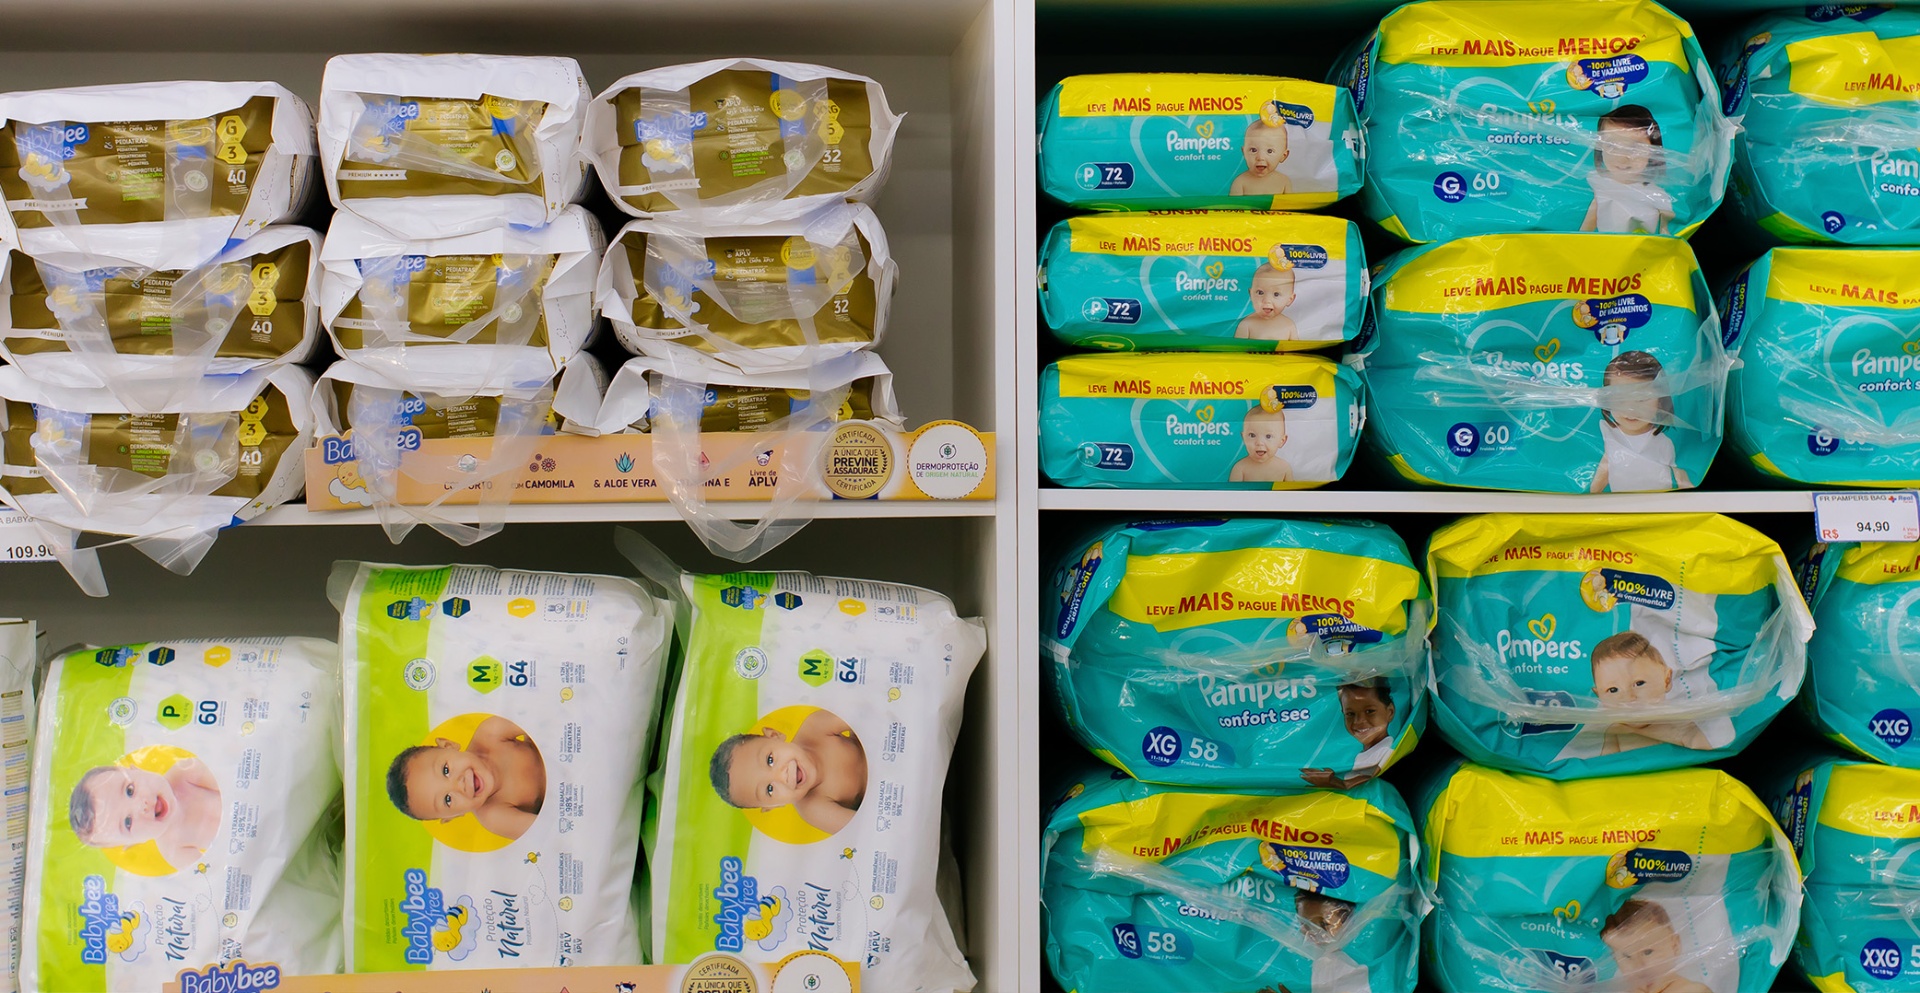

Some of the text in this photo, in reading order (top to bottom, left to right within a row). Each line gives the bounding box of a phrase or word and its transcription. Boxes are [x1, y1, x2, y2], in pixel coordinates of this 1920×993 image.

[1462, 37, 1640, 57] MAIS PAGUE MENOS
[1613, 57, 1631, 66] LIVRE
[1601, 63, 1645, 76] VAZAMENTOS
[1844, 82, 1866, 92] LEVE
[1087, 97, 1244, 112] LEVE MAIS PAGUE MENOS
[1166, 130, 1230, 154] Pampers
[1487, 131, 1542, 146] confort
[227, 146, 237, 159] 3
[822, 149, 842, 163] 32
[1174, 153, 1221, 161] confort sec
[227, 169, 246, 184] 40
[1084, 167, 1094, 182] P
[1105, 167, 1123, 181] 72
[1472, 171, 1500, 191] 60
[1442, 176, 1460, 195] G
[1099, 237, 1253, 252] LEVE MAIS PAGUE MENOS
[1289, 250, 1310, 258] 100%
[1176, 270, 1237, 294] Pampers
[1444, 273, 1642, 297] LEVE MAIS PAGUE MENOS
[258, 291, 268, 305] 3
[1183, 293, 1212, 302] confort
[1618, 297, 1635, 306] LIVRE
[1809, 284, 1837, 295] LEVE
[1841, 284, 1899, 305] MAIS
[833, 300, 849, 314] 32
[1112, 302, 1130, 316] 72
[251, 320, 273, 334] 40
[1088, 380, 1244, 395] LEVE MAIS PAGUE MENOS
[1858, 379, 1912, 392] confort
[737, 396, 768, 404] PEDIATRAS
[1281, 391, 1300, 399] 100%
[247, 424, 256, 436] 3
[1166, 414, 1230, 437] Pampers
[836, 431, 876, 445] CERTIFICADA
[1173, 437, 1221, 446] confort sec
[1484, 426, 1510, 445] 60
[240, 450, 262, 465] 40
[841, 447, 862, 457] ÚNICA
[865, 449, 878, 457] QUE
[1084, 446, 1095, 459] P
[1105, 448, 1123, 462] 72
[834, 457, 878, 467] PREVINE
[916, 462, 979, 472] DERMOPROTEÇÃO
[834, 466, 878, 475] ASSADURAS
[525, 479, 575, 489] CAMOMILA
[604, 478, 628, 488] ALOE
[631, 478, 657, 488] VERA
[749, 476, 778, 487] APLV
[836, 479, 877, 492] CERTIFICADA
[1822, 529, 1839, 540] R$
[1857, 521, 1890, 533] 94,90
[1504, 546, 1633, 564] MAIS MENOS
[1613, 579, 1673, 600] 100% LIVRE
[1146, 592, 1356, 619] LEVE MAIS PAGUE MENOS
[473, 665, 490, 682] M
[509, 659, 528, 687] 64
[803, 658, 820, 677] M
[839, 656, 858, 684] 64
[1546, 665, 1569, 674] sec
[163, 705, 181, 717] P
[199, 700, 218, 725] 60
[1219, 708, 1310, 728] confort sec
[1872, 719, 1909, 736] XXG
[890, 722, 898, 752] PEDIATRAS
[1146, 732, 1177, 756] XG
[1188, 737, 1219, 762] 58
[244, 749, 252, 780] PEDIATRAS
[878, 780, 886, 814] ULTRAMACIA
[238, 816, 246, 833] 98%
[1133, 818, 1334, 857] LEVE MAIS PAGUE MENOS
[1501, 829, 1656, 845] LEVE MAIS PAGUE MENOS
[1309, 851, 1332, 861] LIVRE
[1633, 857, 1690, 872] 100% LIVRE
[737, 880, 758, 907] free
[101, 895, 120, 922] free
[424, 892, 445, 918] free
[522, 896, 530, 917] Natural
[717, 859, 745, 949] Babybee
[81, 877, 107, 962] Babybee
[402, 871, 433, 961] Babybee
[796, 890, 809, 934] Proteção
[804, 882, 835, 952] Natural
[155, 904, 166, 946] Proteção
[483, 898, 497, 942] Proteção
[490, 889, 525, 959] Natural
[162, 896, 190, 962] Natural
[873, 930, 881, 953] APLV
[1147, 931, 1176, 953] 58
[1863, 948, 1899, 968] XXG
[698, 963, 740, 977] CERTIFICADA
[184, 966, 277, 993] Babybee
[728, 981, 742, 990] QUE
